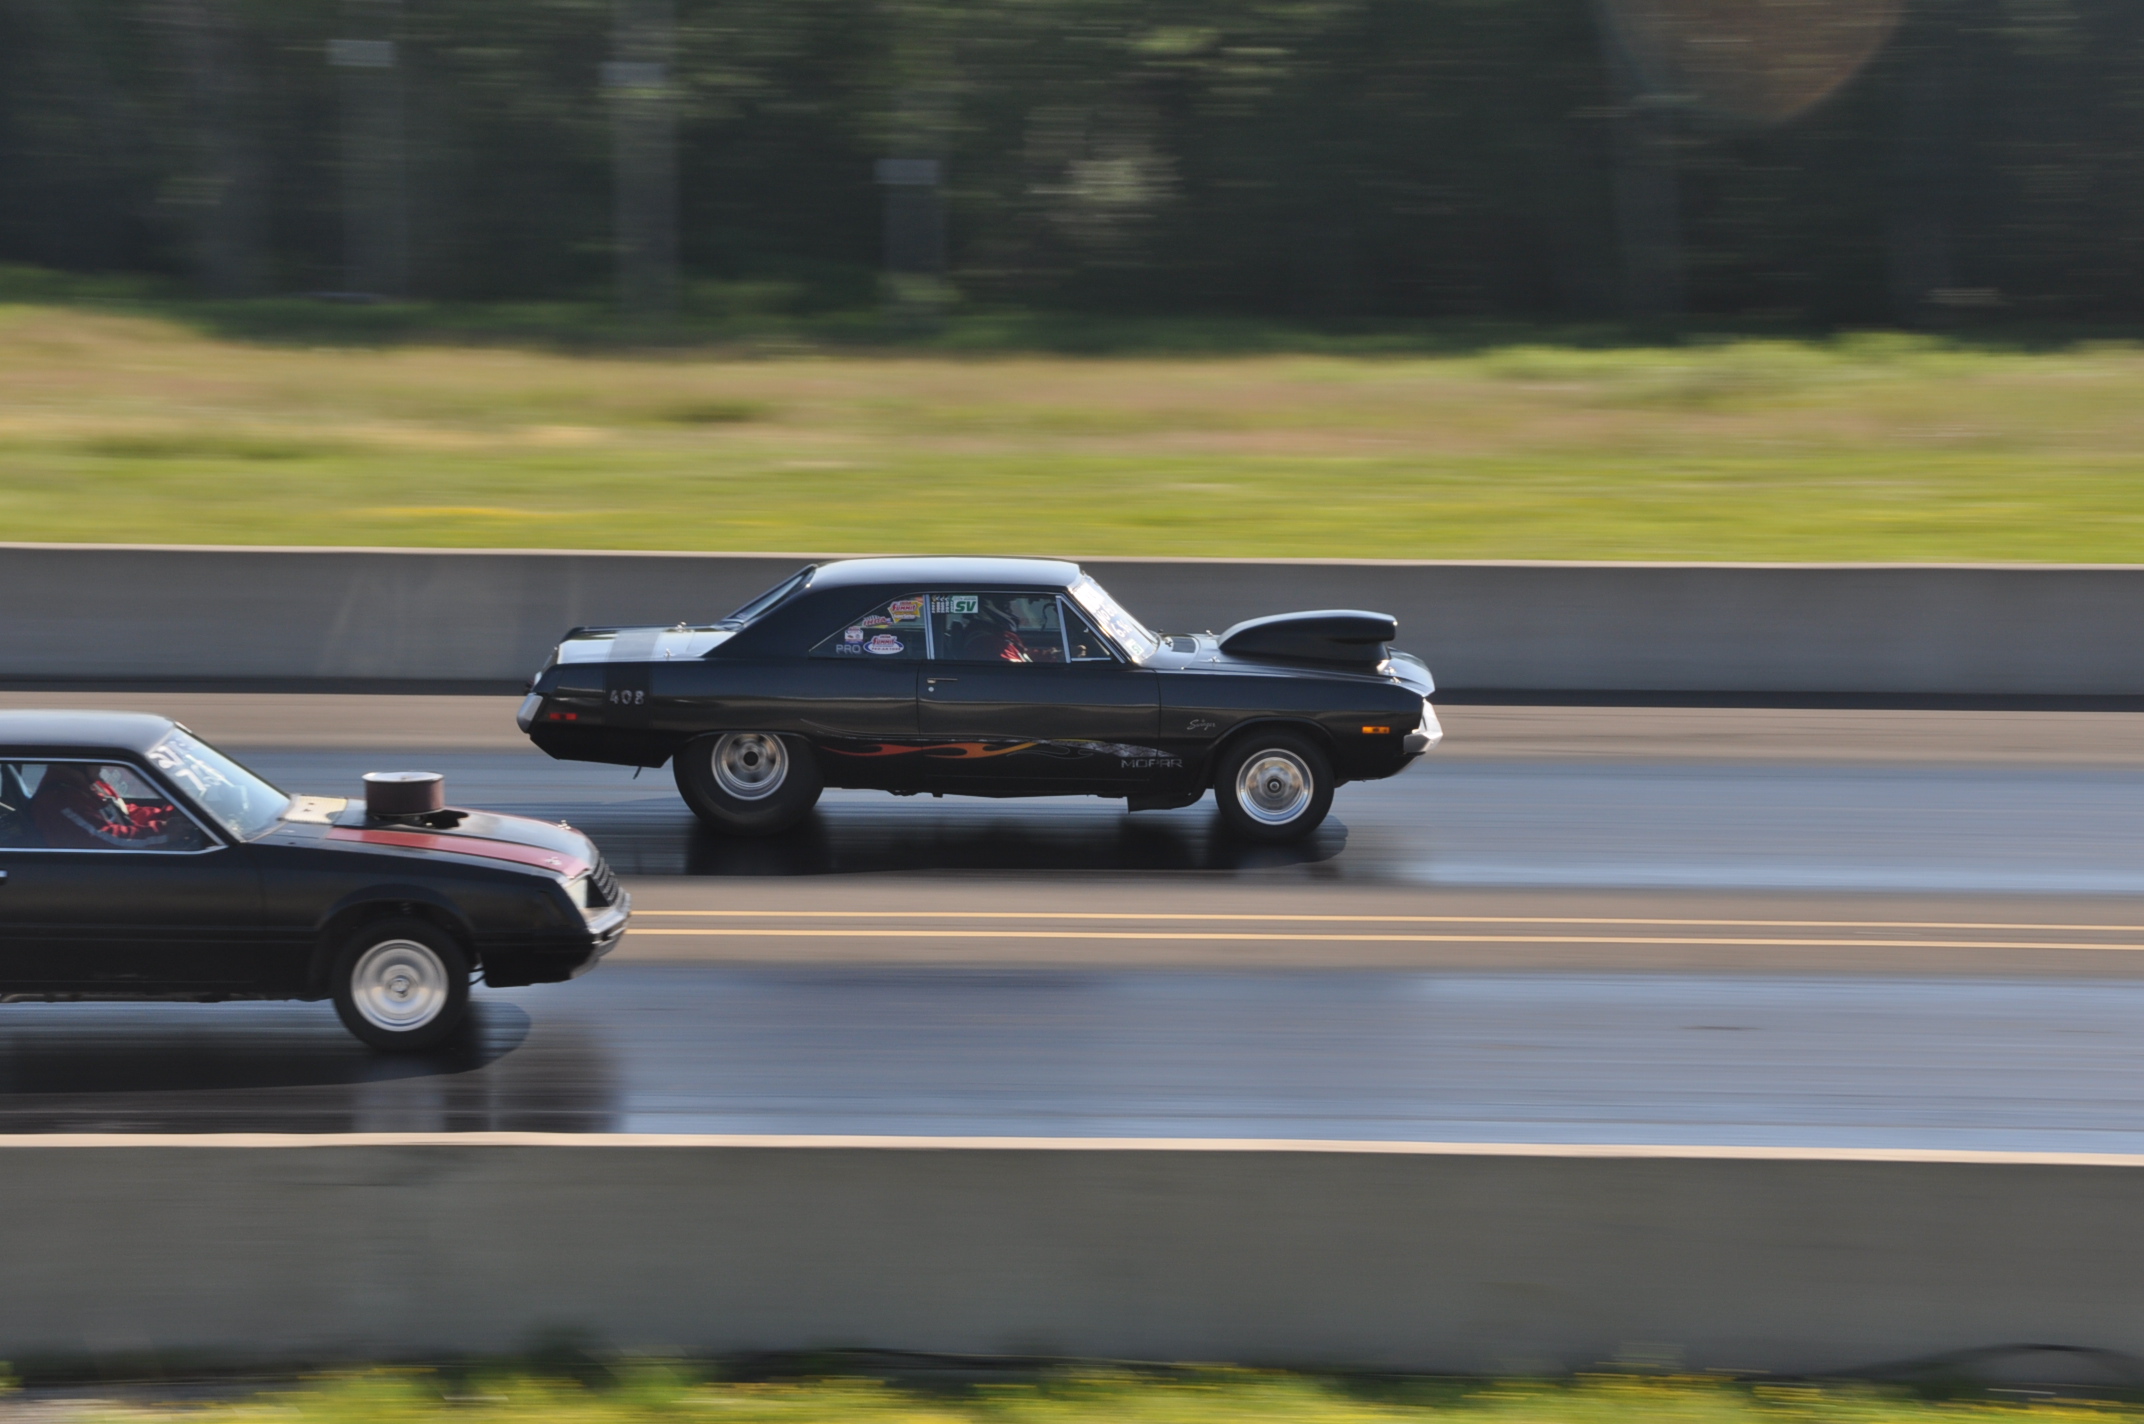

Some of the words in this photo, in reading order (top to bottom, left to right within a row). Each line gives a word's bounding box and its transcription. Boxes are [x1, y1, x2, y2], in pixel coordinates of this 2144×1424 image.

[955, 600, 977, 612] SV
[836, 644, 861, 654] PRO
[610, 689, 645, 705] 408
[1121, 759, 1183, 768] MOPAR
